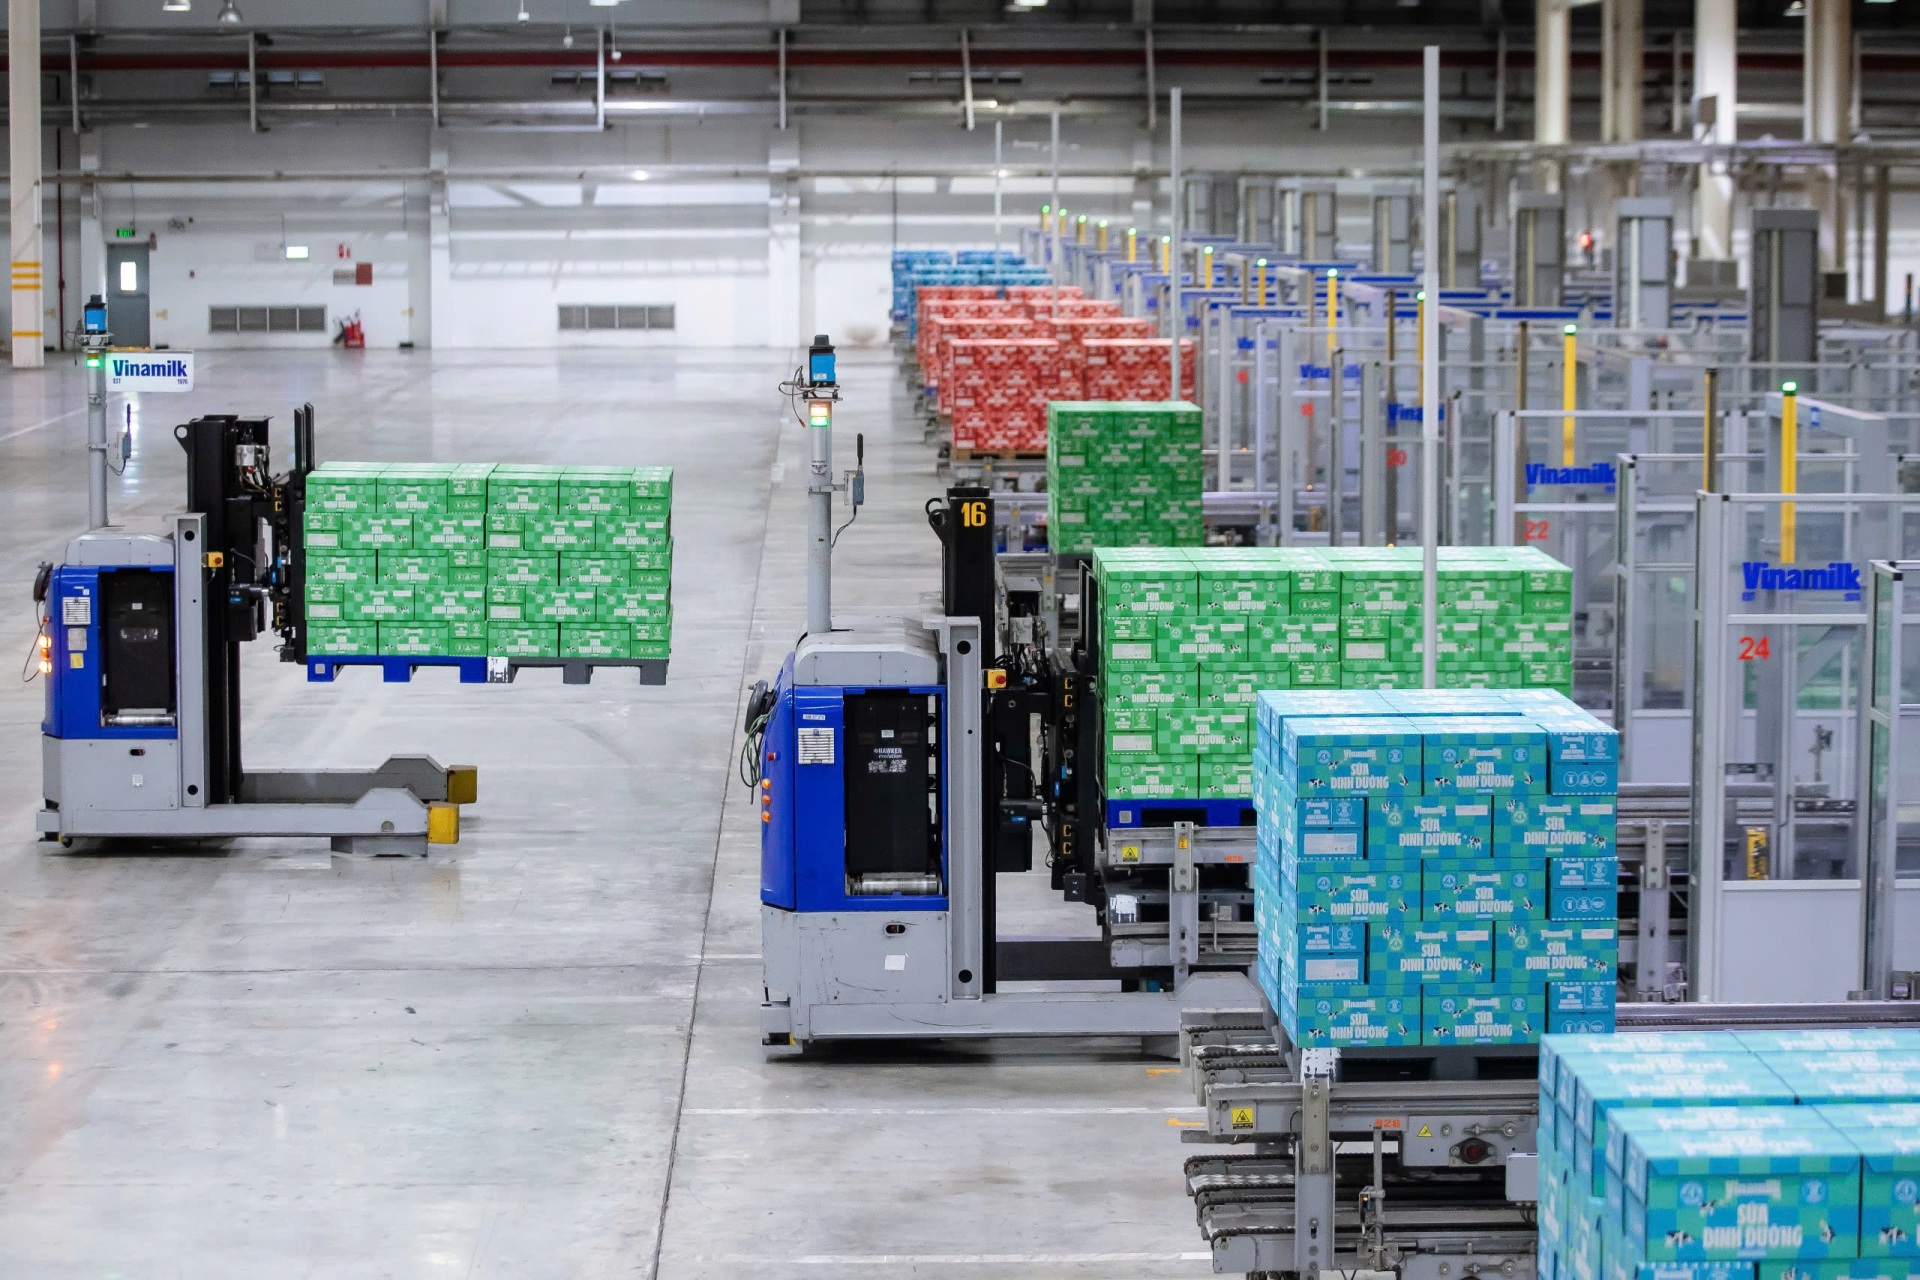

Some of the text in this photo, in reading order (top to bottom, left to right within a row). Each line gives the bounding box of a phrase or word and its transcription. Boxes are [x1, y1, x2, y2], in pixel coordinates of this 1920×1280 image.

[113, 360, 187, 377] Vinamilk
[1525, 463, 1616, 485] Vinamilk
[961, 502, 986, 527] 16
[1523, 521, 1549, 540] 22
[1742, 562, 1860, 590] Vinamilk
[1738, 636, 1770, 660] 24
